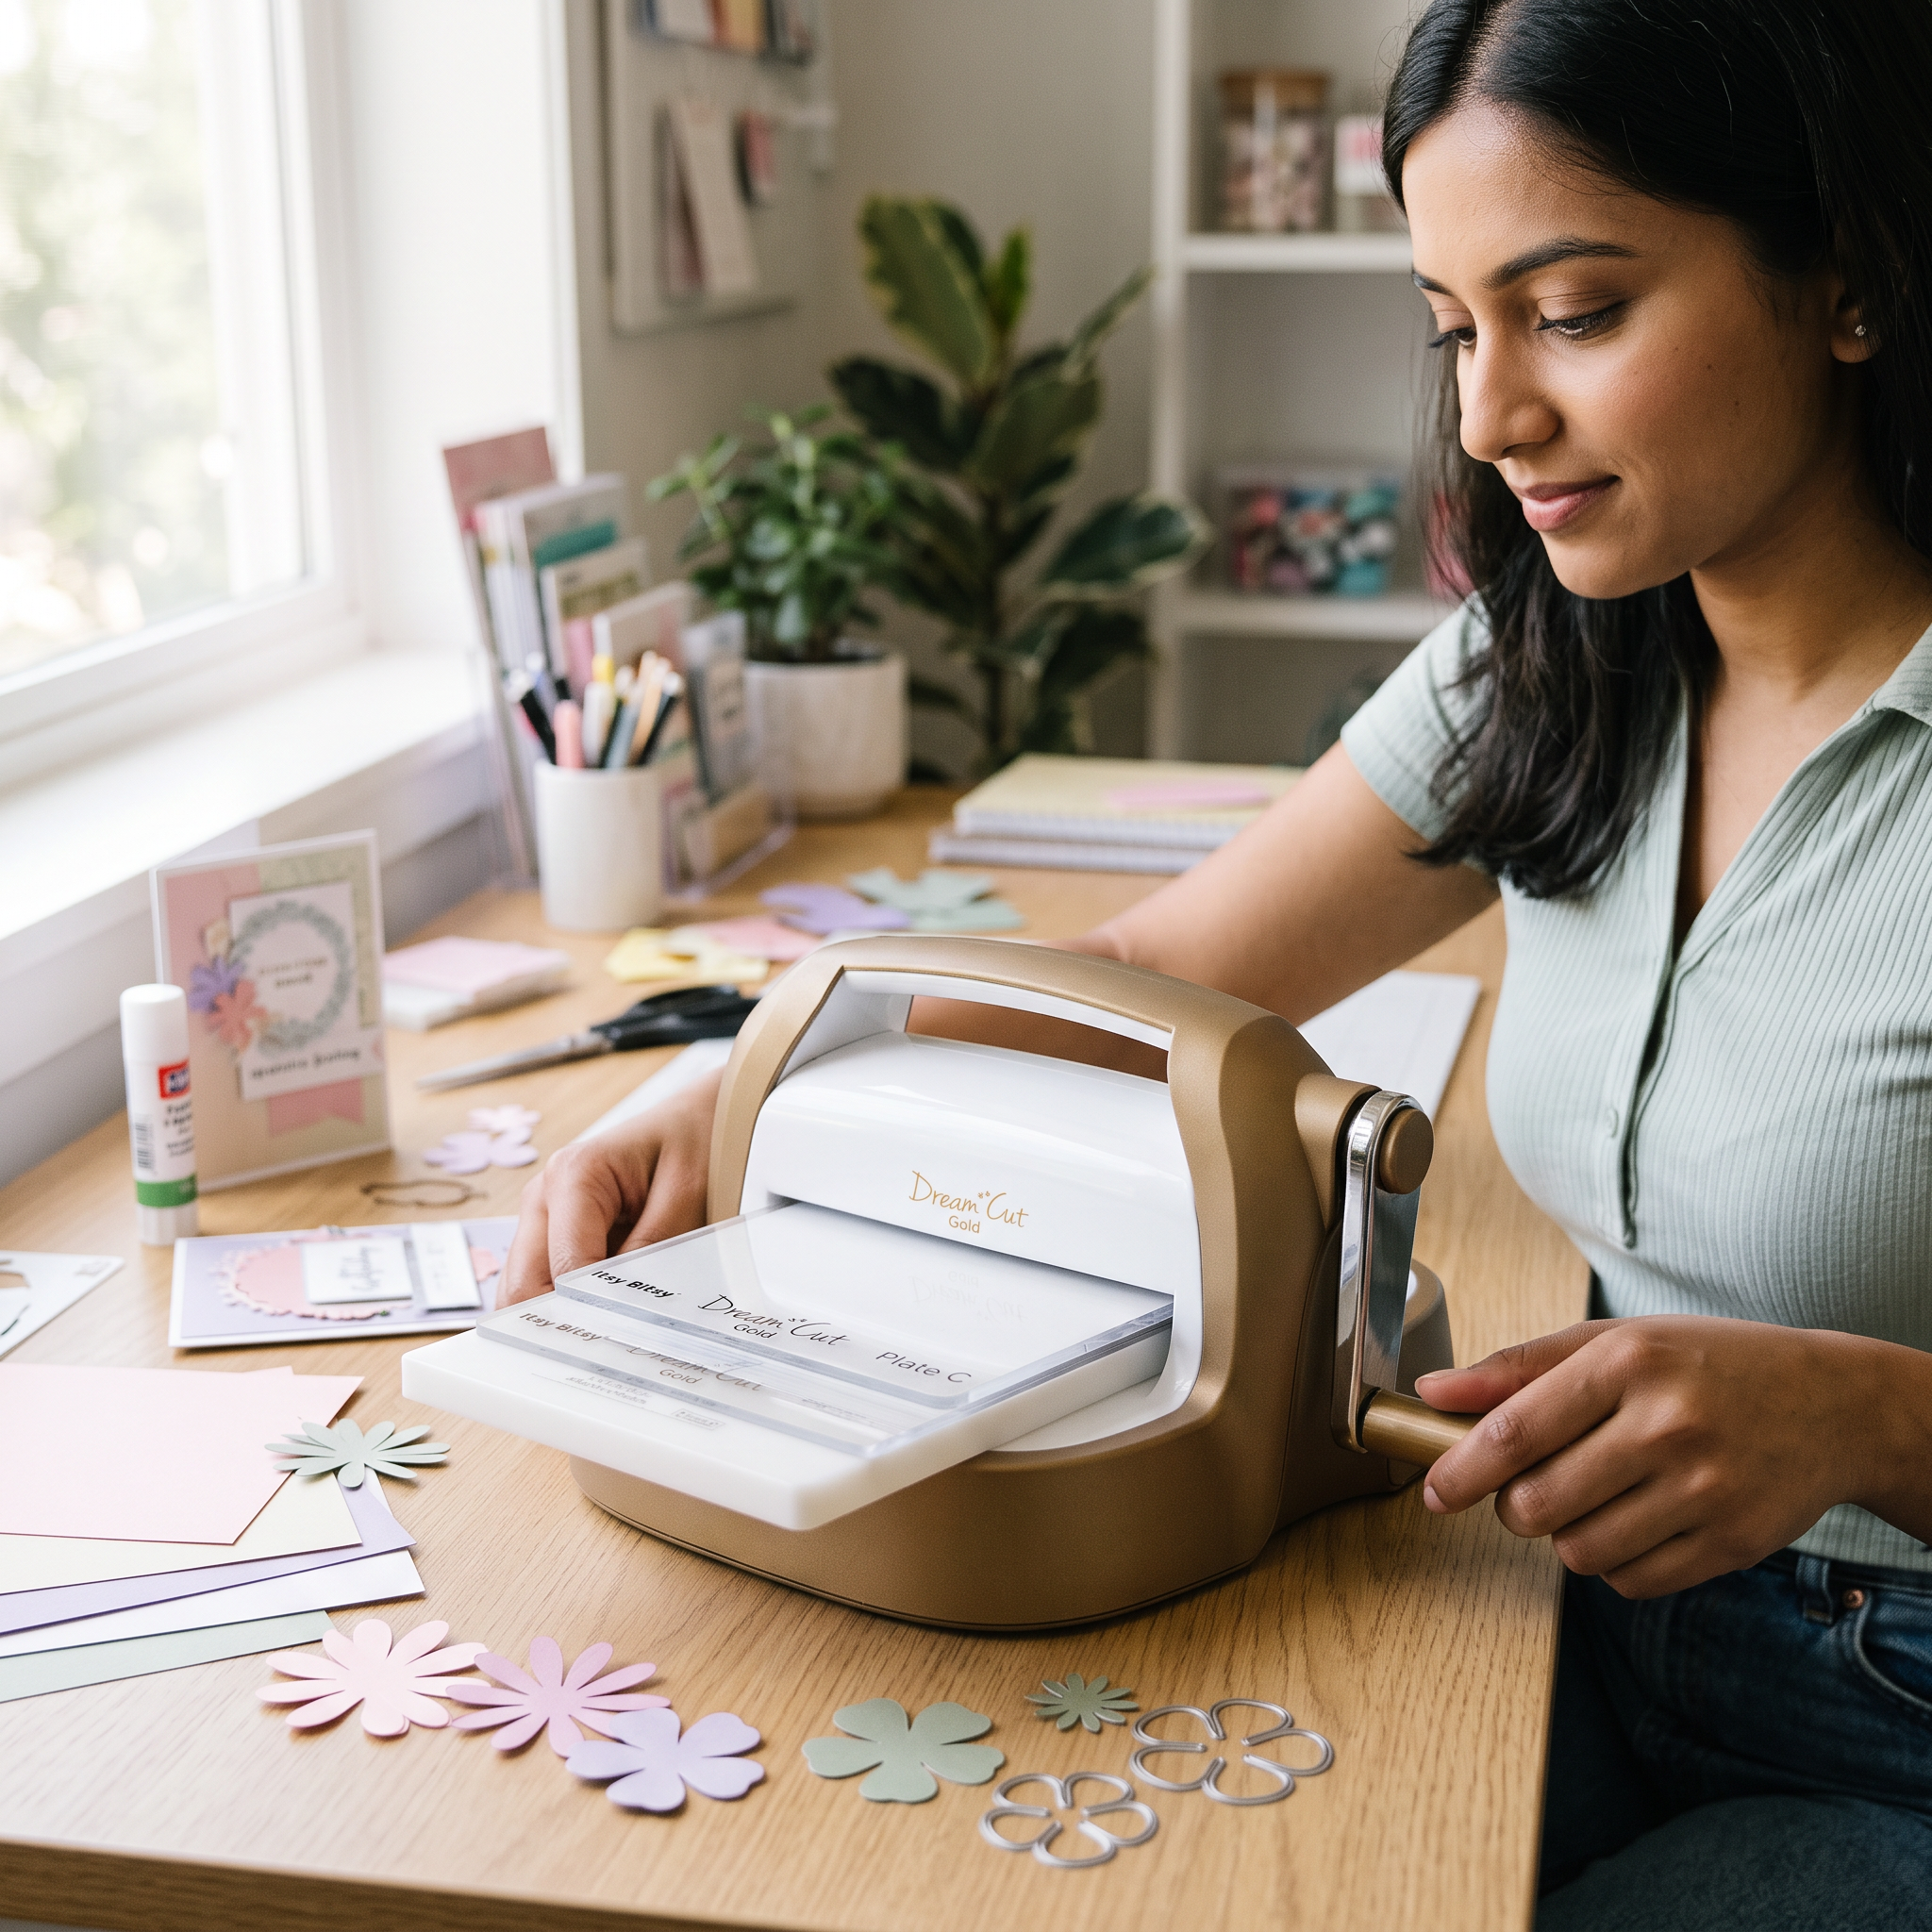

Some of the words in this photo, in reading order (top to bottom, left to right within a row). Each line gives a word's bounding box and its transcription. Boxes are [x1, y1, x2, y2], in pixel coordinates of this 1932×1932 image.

[908, 1171, 979, 1213] Dream
[987, 1192, 1029, 1227] Cut
[948, 1215, 980, 1233] Gold
[591, 1271, 627, 1284] Itsy
[520, 1313, 556, 1327] Itsy
[697, 1293, 784, 1329] Dream
[790, 1323, 850, 1346] Cut
[733, 1324, 778, 1340] Gold
[875, 1351, 941, 1376] Plate
[947, 1372, 972, 1383] C
[659, 1369, 703, 1385] Gold
